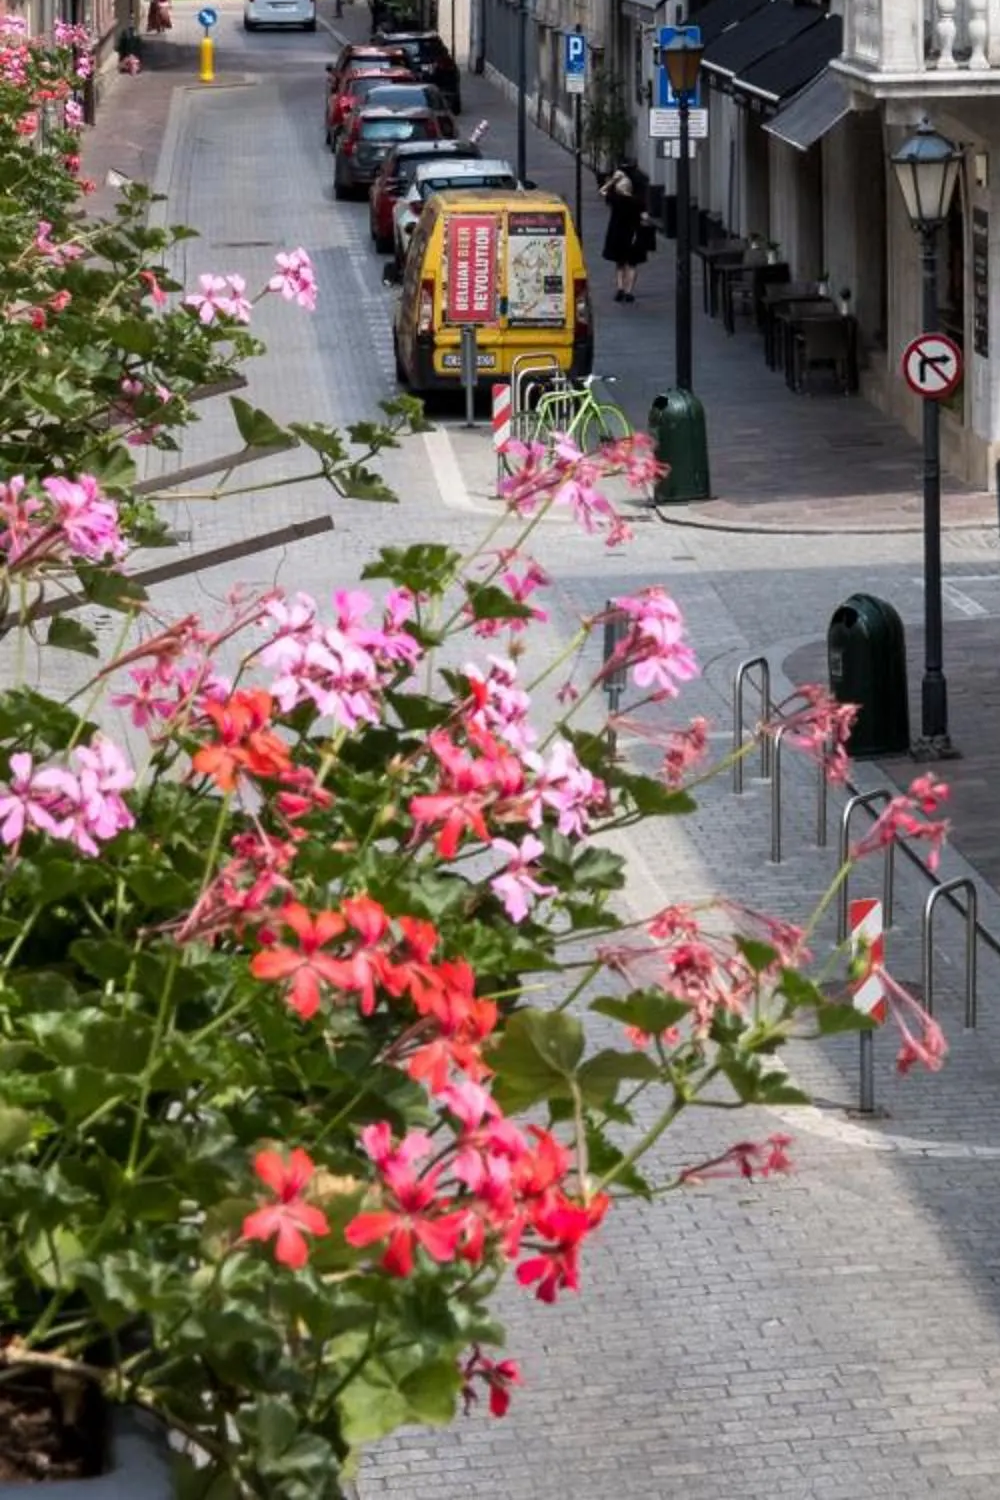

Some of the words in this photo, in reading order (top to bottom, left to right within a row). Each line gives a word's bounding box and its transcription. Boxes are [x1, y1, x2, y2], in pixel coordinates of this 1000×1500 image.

[569, 37, 582, 61] P
[457, 227, 471, 257] BEER
[455, 261, 469, 311] BELGIAN
[473, 227, 490, 311] REVOLUTION
